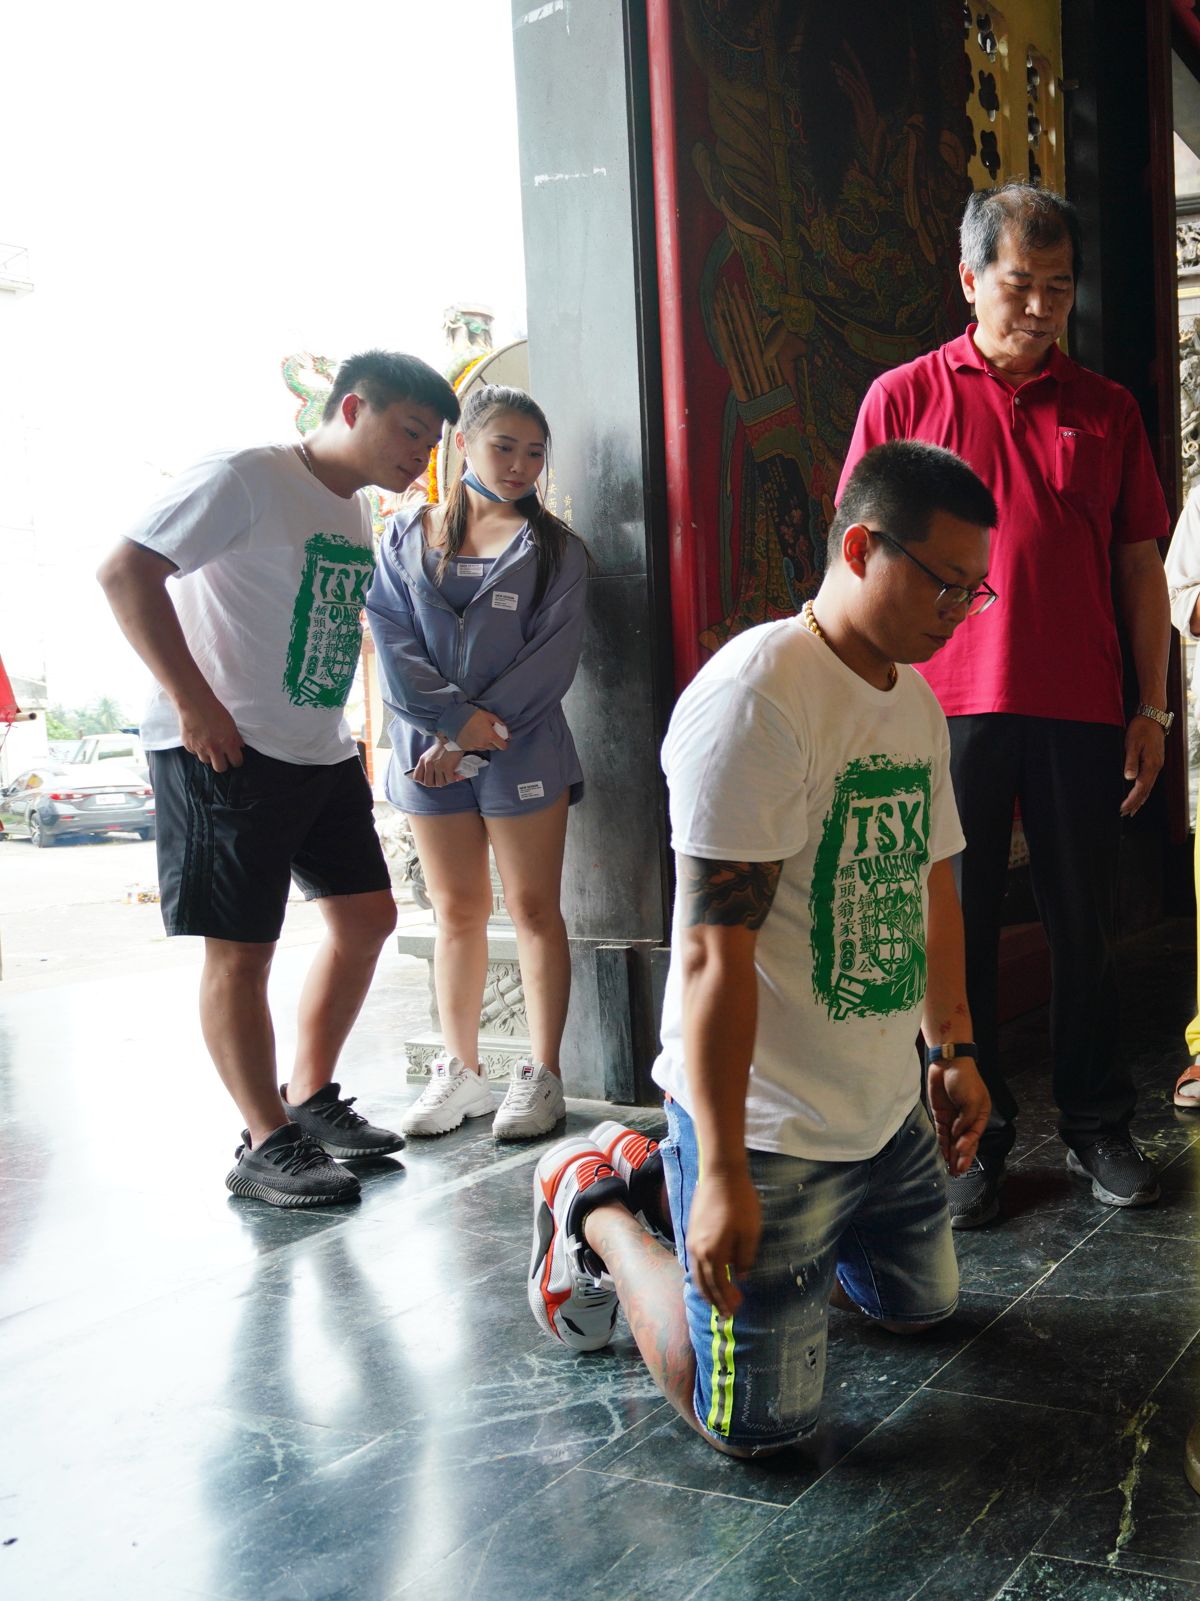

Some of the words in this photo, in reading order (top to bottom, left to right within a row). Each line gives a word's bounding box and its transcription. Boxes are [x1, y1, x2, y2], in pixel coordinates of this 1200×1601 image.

[319, 566, 369, 605] TSX
[851, 800, 924, 856] TSX
[836, 864, 857, 938] 橋頭翁家
